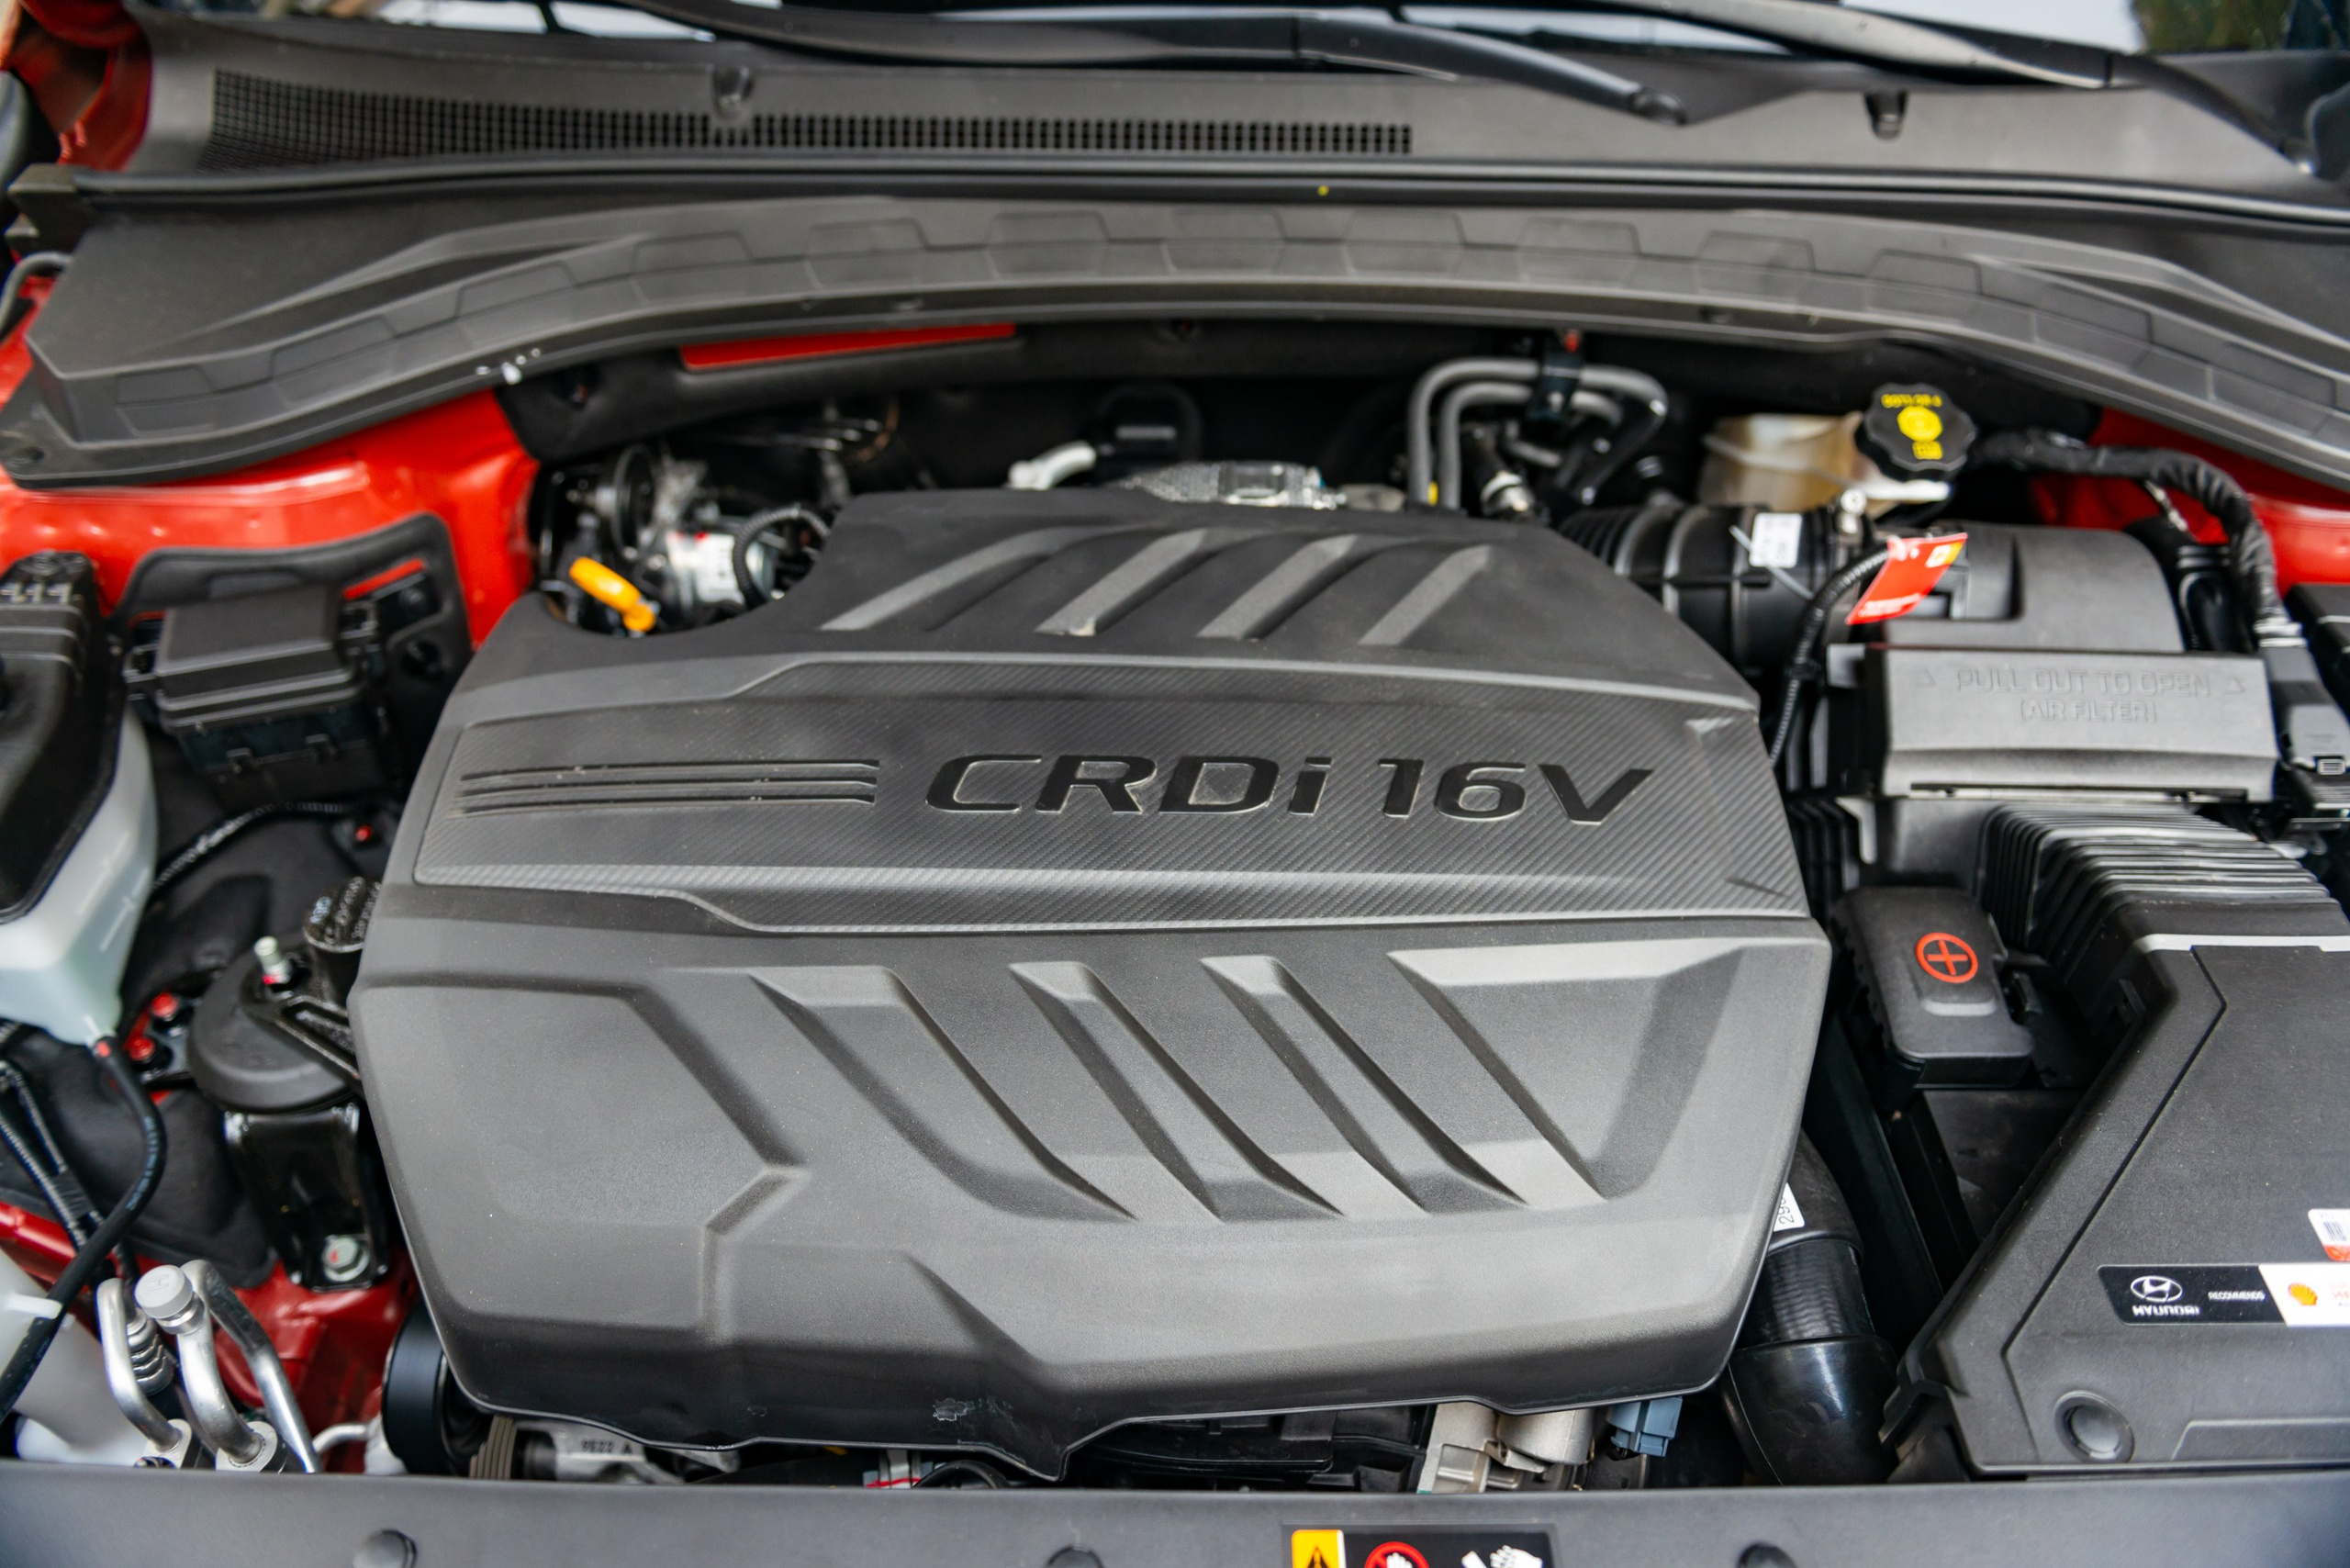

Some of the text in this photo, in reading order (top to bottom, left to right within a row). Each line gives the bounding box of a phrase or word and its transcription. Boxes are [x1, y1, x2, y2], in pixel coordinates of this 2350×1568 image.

[1956, 668, 2211, 698] PULL OUT TO OPEN
[2020, 699, 2158, 725] (AIR FILTER)
[925, 754, 1652, 825] CRDi 16V
[2208, 1290, 2266, 1301] RECOMMENDS
[2132, 1305, 2200, 1316] HYUNDAI
